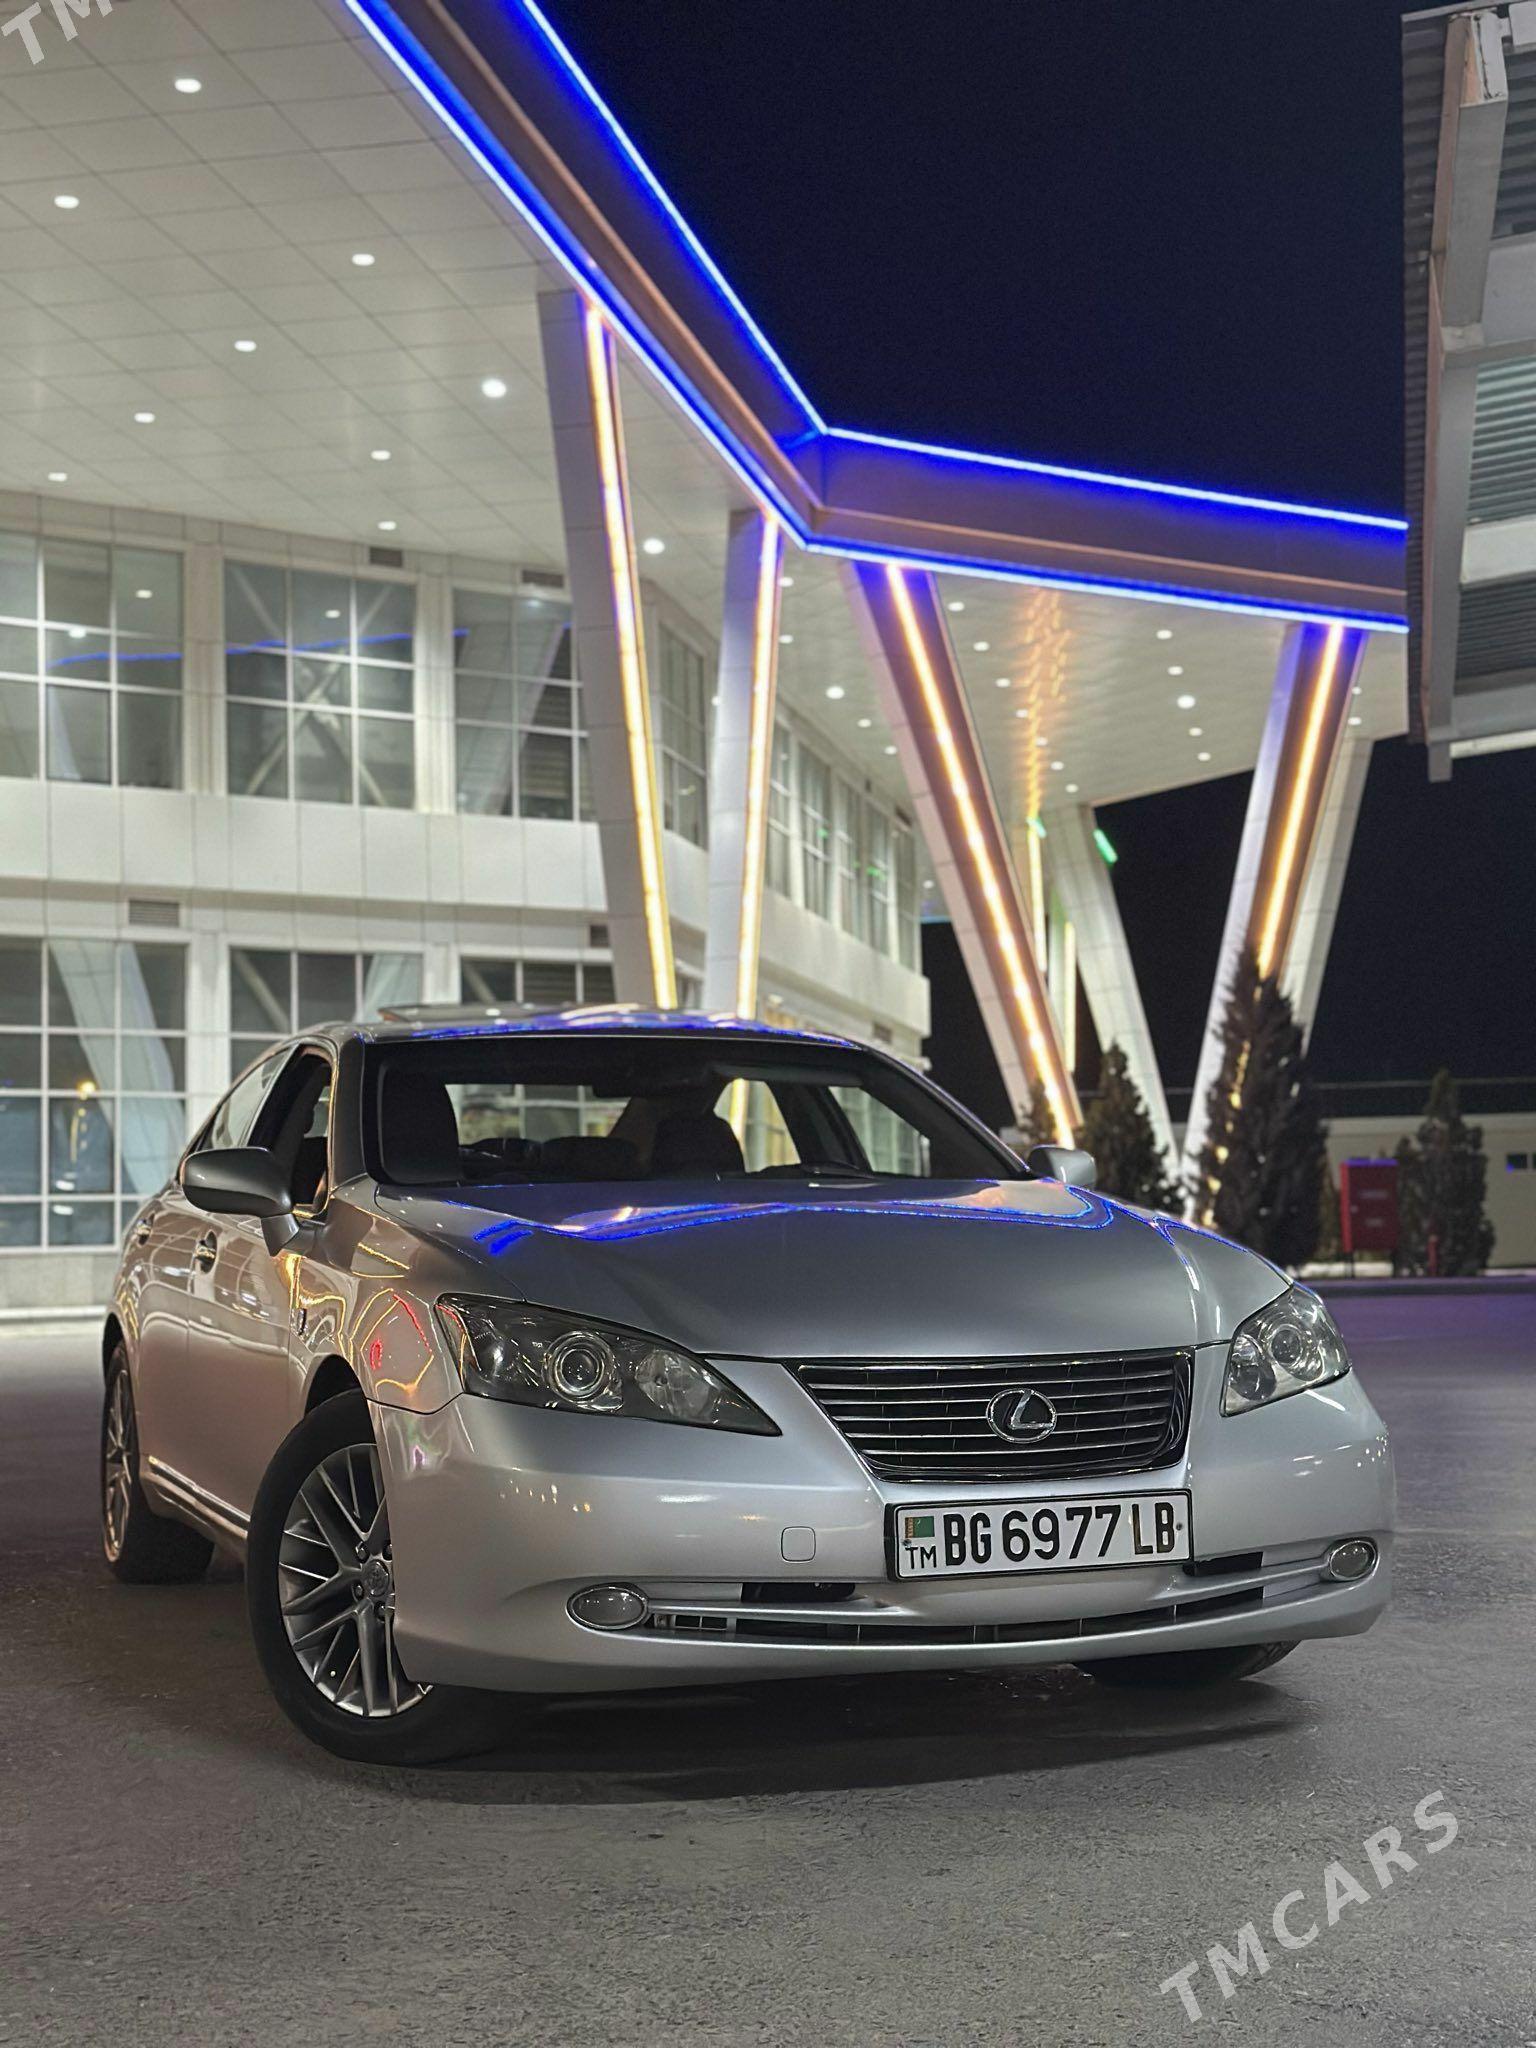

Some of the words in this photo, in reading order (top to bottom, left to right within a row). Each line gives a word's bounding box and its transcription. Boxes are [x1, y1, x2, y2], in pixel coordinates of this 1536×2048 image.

[943, 1512, 991, 1566] BG
[1002, 1504, 1121, 1562] 6977
[1132, 1502, 1175, 1555] LB
[904, 1545, 937, 1570] TM
